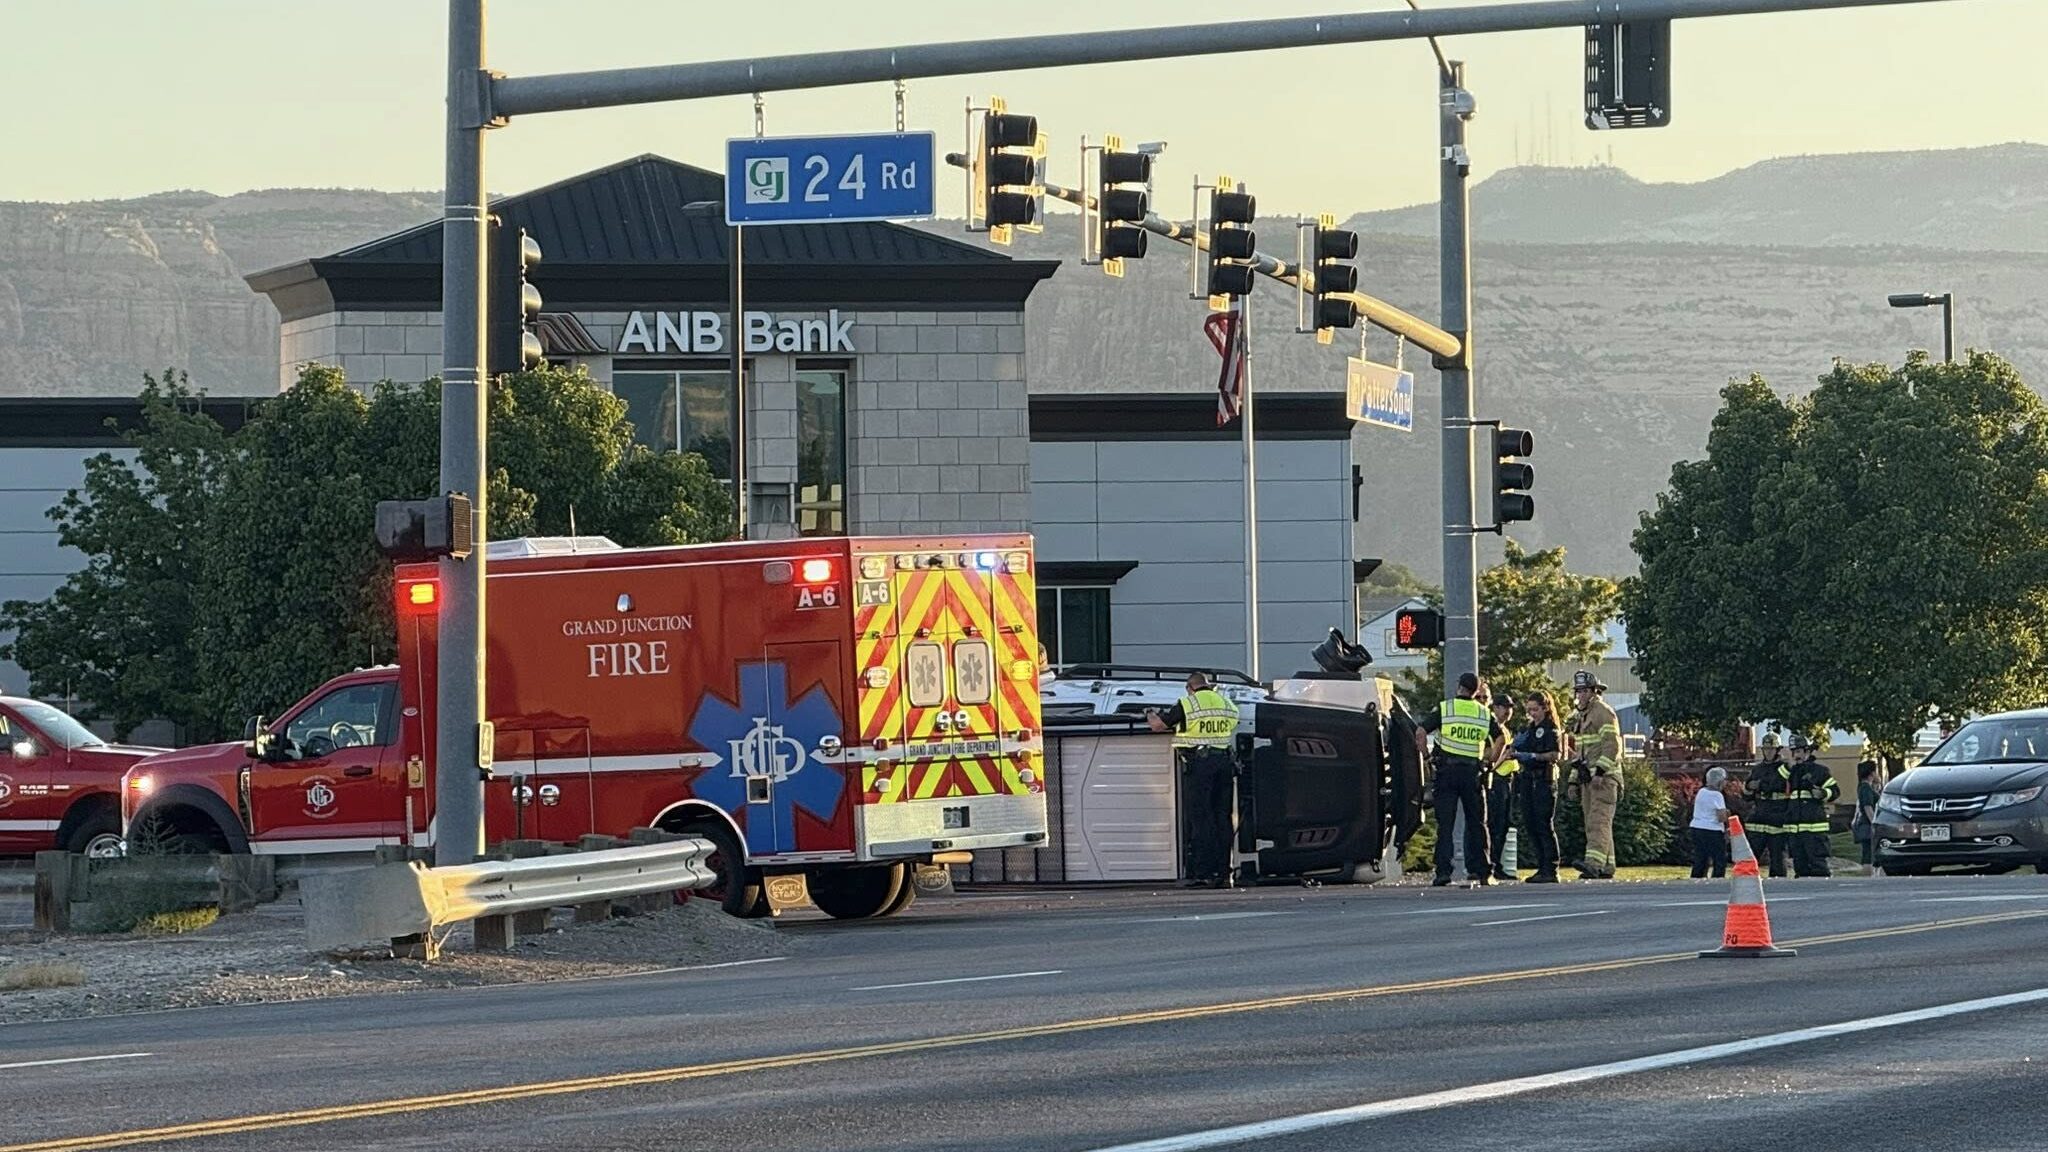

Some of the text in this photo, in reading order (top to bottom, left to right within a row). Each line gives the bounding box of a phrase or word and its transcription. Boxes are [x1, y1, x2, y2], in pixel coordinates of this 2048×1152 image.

[804, 154, 916, 202] 24 Rd
[617, 309, 856, 353] ANB Bank
[1361, 375, 1404, 416] Patterson
[798, 585, 836, 608] A-6
[861, 582, 889, 604] A-6
[562, 614, 693, 636] GRAND JUNCTION
[586, 640, 670, 678] FIRE
[1450, 726, 1482, 740] POLICE
[909, 744, 926, 756] GRAND
[928, 743, 952, 755] JUNCTION
